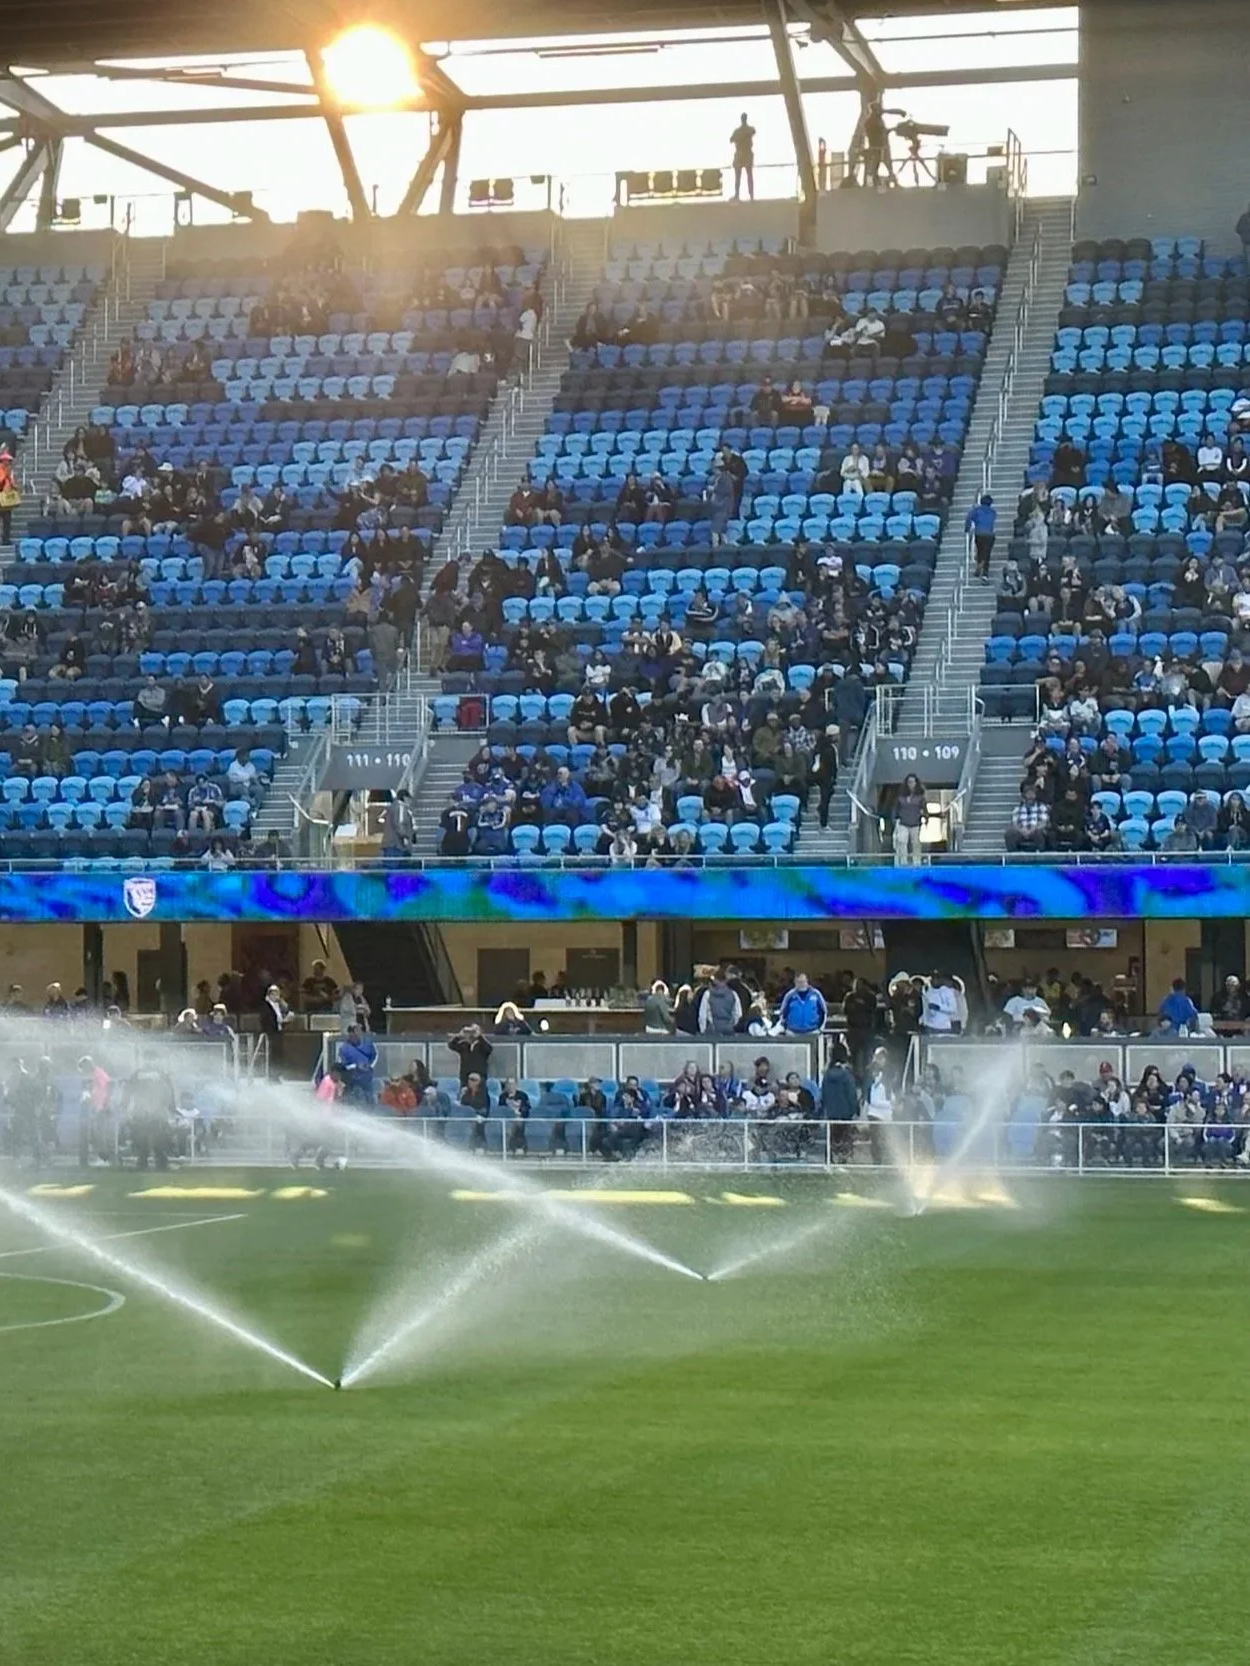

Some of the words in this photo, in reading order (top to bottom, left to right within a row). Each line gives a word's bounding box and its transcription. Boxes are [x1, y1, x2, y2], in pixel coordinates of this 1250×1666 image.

[347, 754, 369, 767] 111
[387, 753, 411, 767] 110
[893, 747, 917, 760] 110
[934, 746, 960, 760] 109
